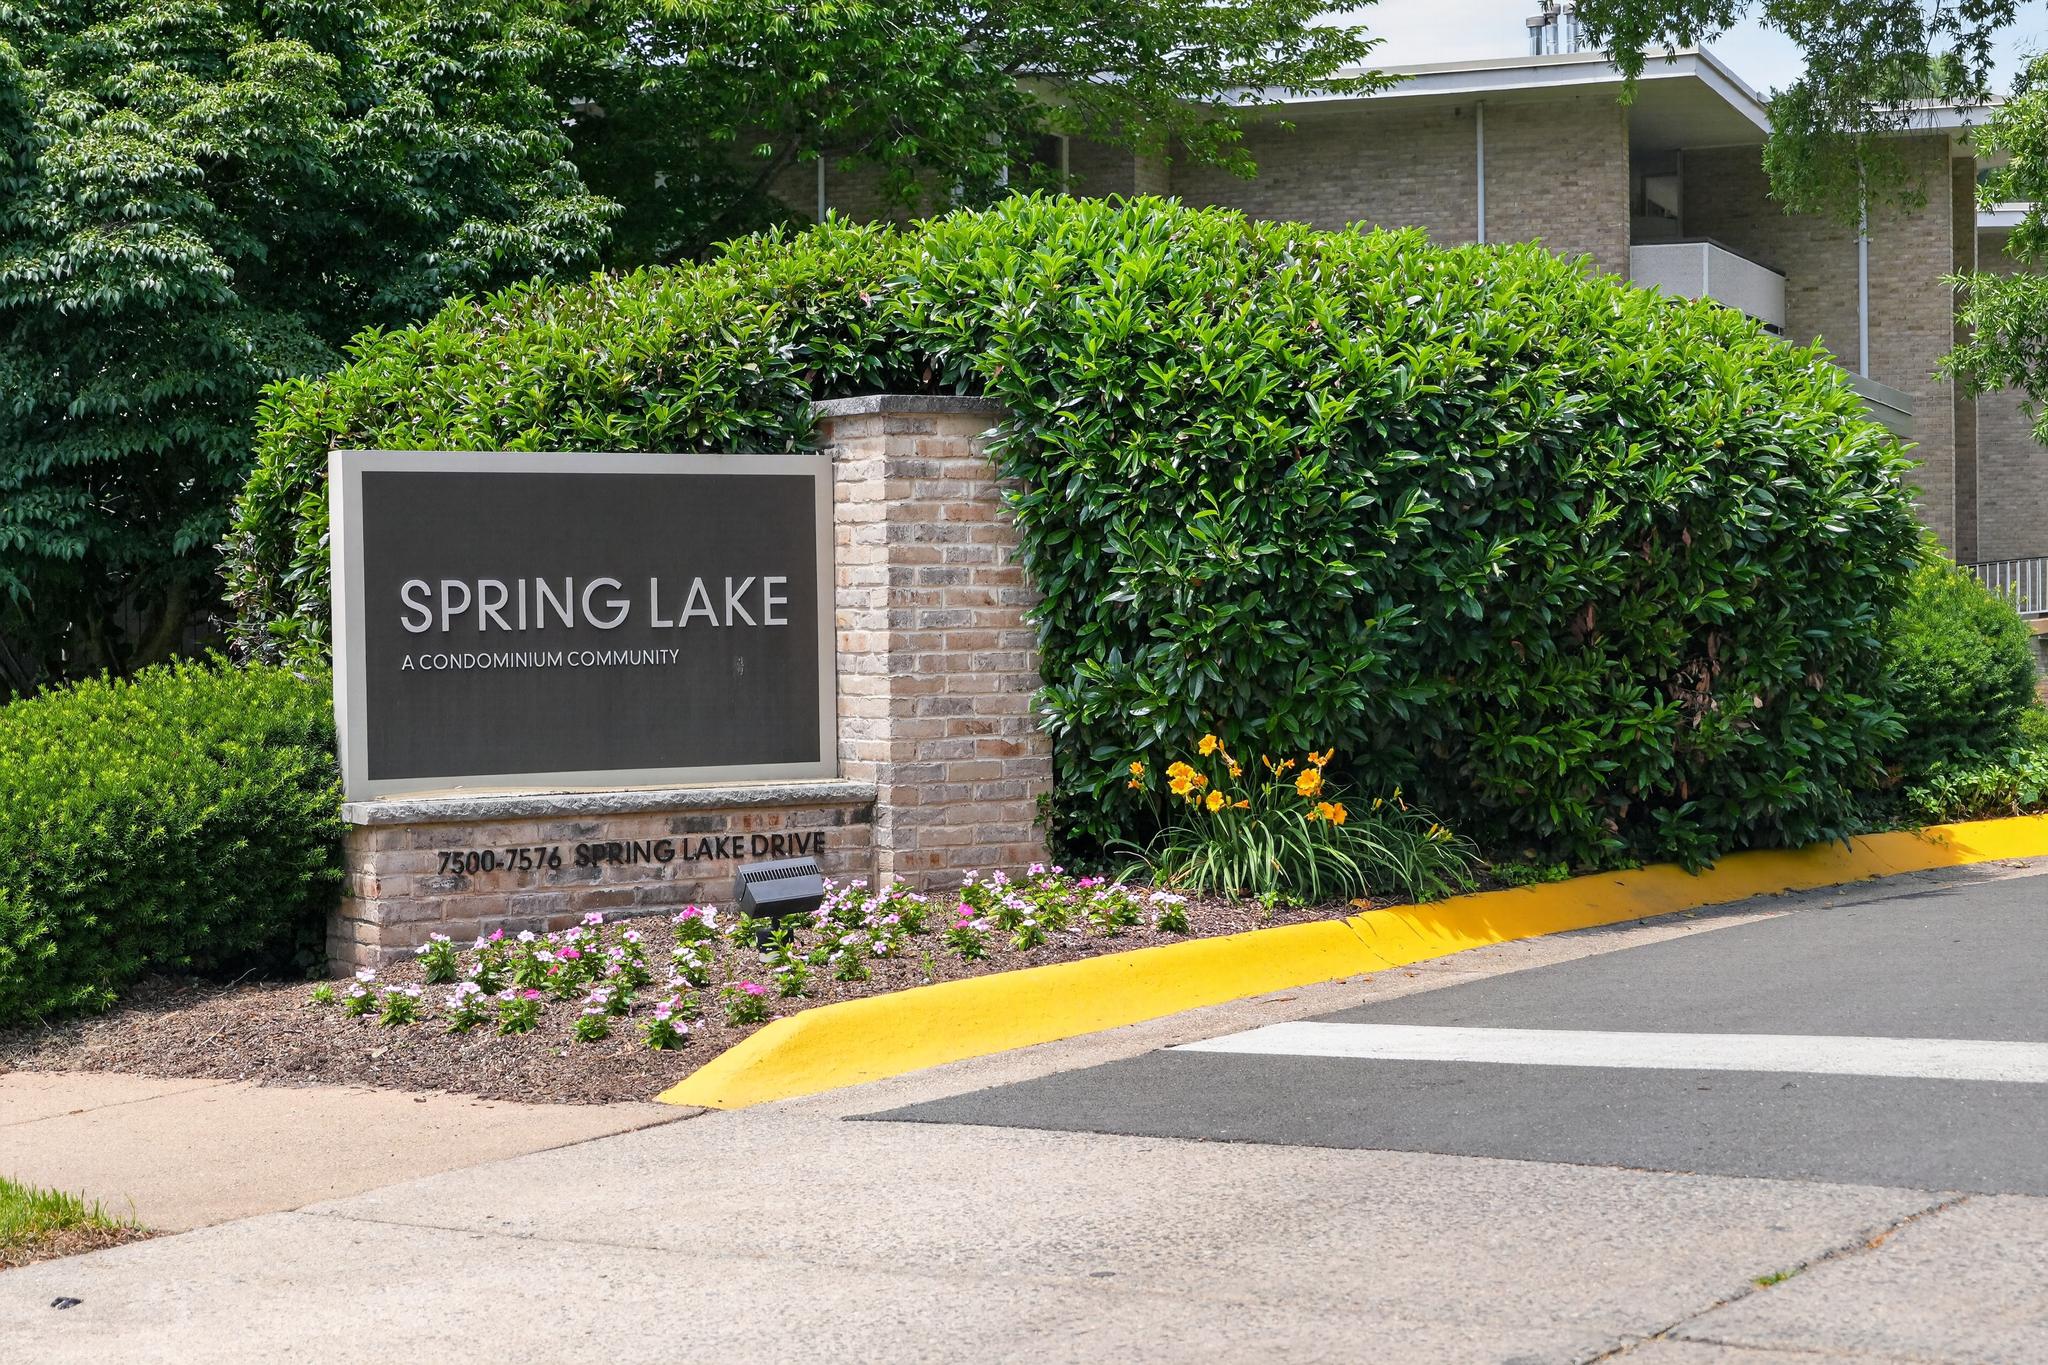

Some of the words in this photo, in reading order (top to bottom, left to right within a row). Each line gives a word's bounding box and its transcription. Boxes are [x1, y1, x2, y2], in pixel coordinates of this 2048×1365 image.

[400, 577, 630, 633] SPRING
[650, 576, 788, 628] LAKE
[401, 653, 415, 671] A
[419, 651, 563, 670] CONDOMINIUM
[568, 649, 680, 667] COMMUNITY
[437, 846, 562, 875] 7500-7576
[574, 838, 675, 867] SPRING
[683, 835, 745, 861] LAKE
[751, 832, 826, 857] DRIVE
